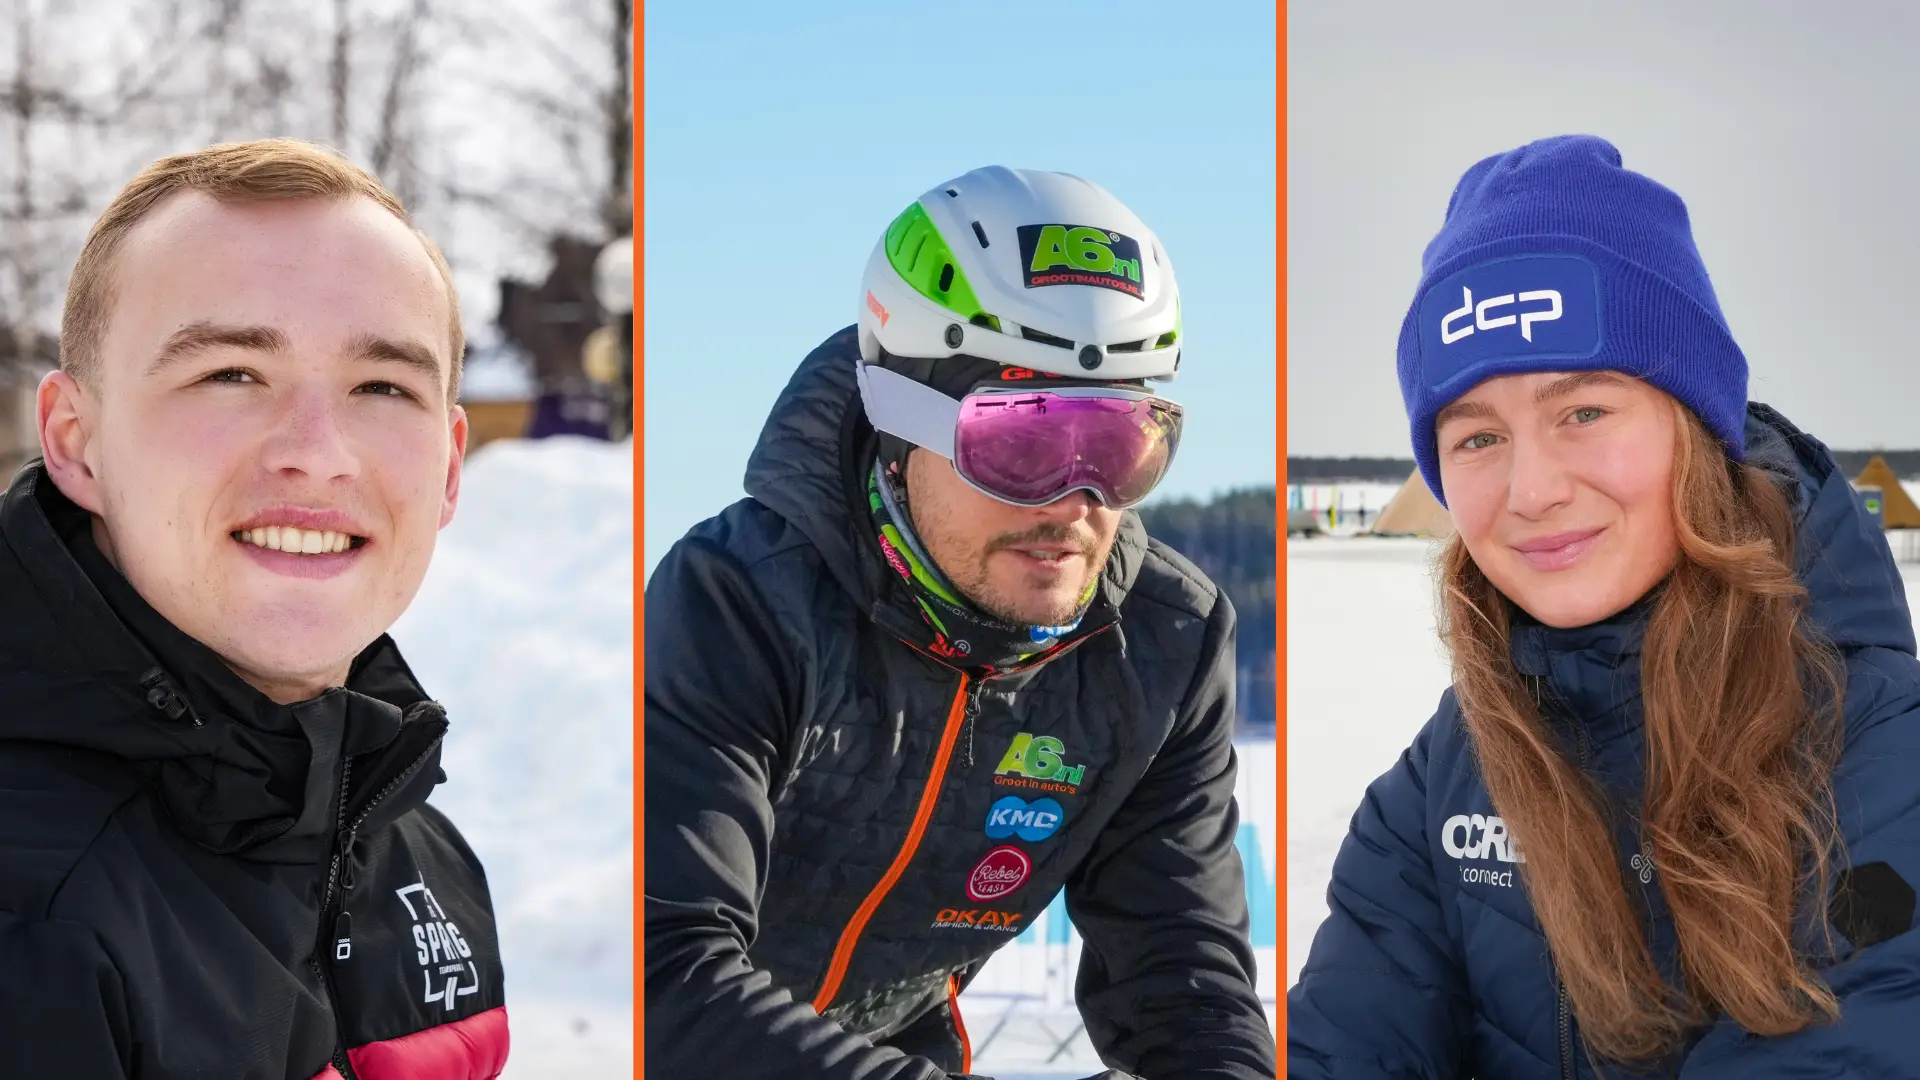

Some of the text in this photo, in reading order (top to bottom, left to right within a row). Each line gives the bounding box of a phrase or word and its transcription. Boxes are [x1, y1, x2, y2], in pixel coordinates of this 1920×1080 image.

[1441, 285, 1563, 345] dcp
[994, 776, 1027, 789] Groot
[1041, 782, 1076, 794] auto's
[989, 808, 1058, 829] KMC
[974, 865, 1021, 882] Rebel
[930, 921, 973, 930] FASHION
[983, 924, 1018, 932] JEANS
[936, 908, 1024, 927] OKAY
